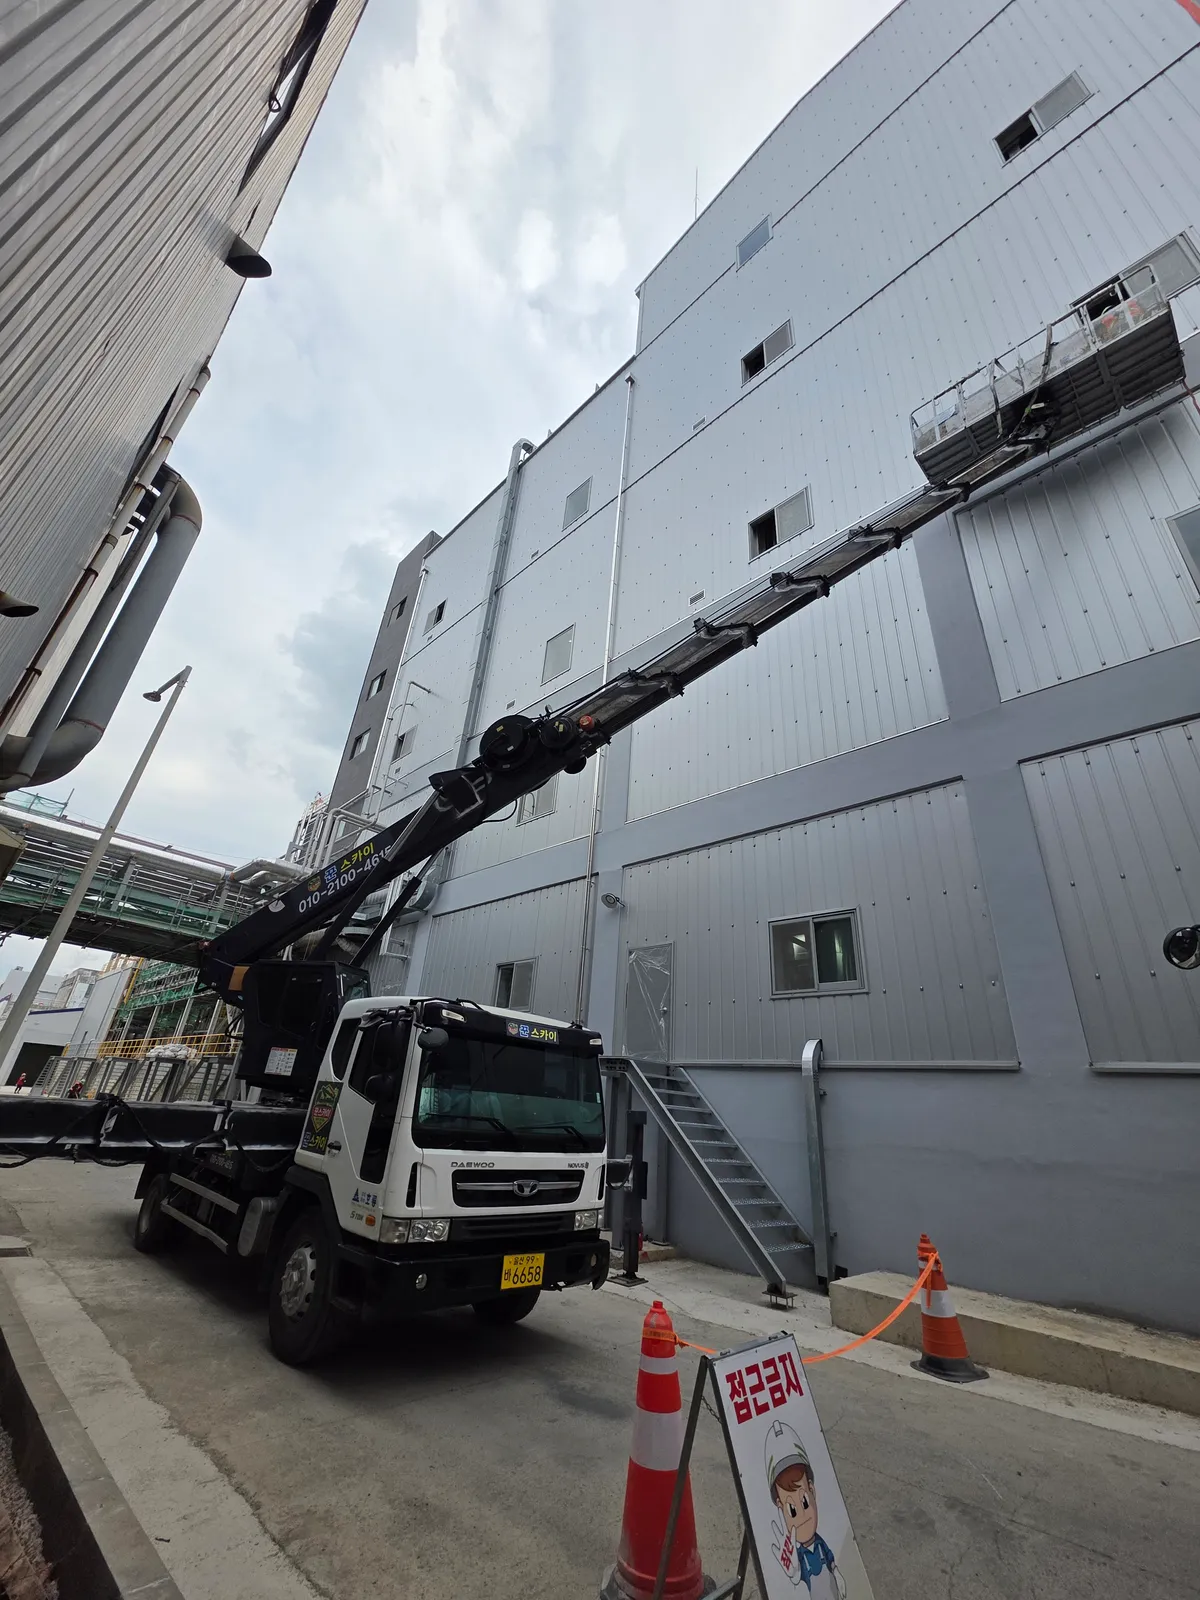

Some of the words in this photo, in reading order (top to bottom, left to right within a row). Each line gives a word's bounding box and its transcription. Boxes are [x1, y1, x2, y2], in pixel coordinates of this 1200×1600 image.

[340, 842, 374, 872] 스카이
[531, 1028, 557, 1042] 스카이
[512, 1265, 541, 1284] 6658
[725, 1352, 804, 1424] 접근금지
